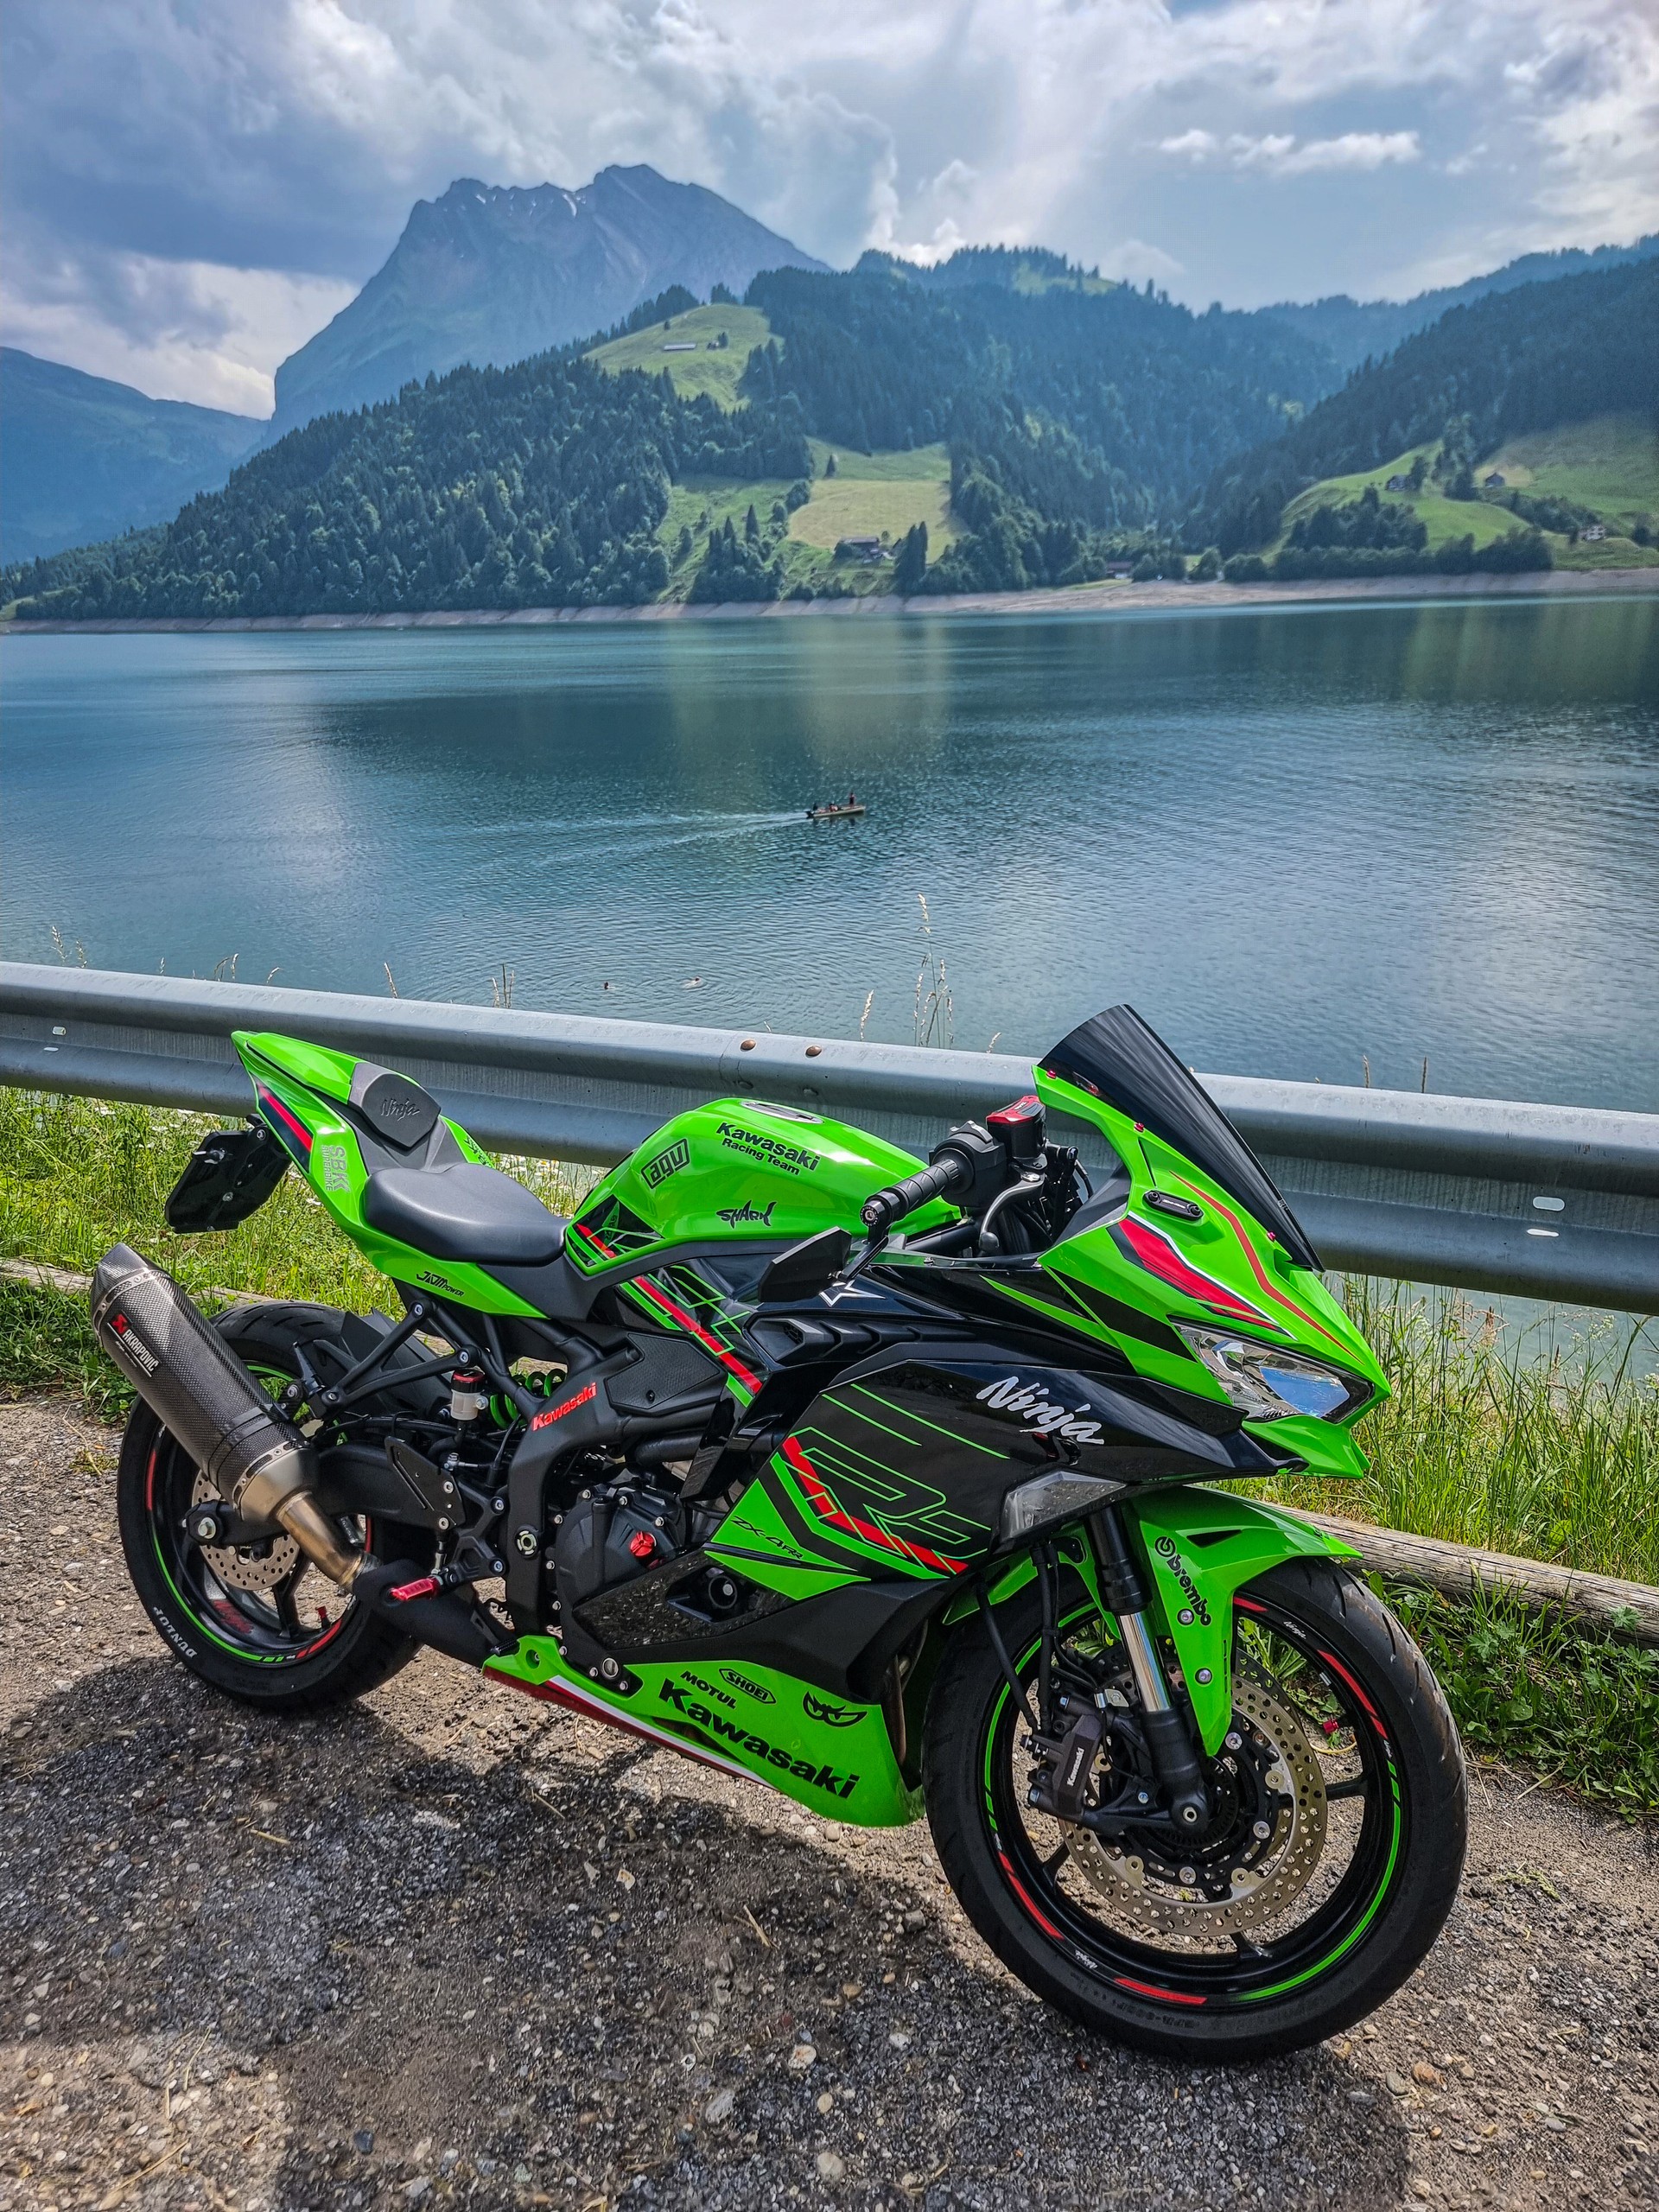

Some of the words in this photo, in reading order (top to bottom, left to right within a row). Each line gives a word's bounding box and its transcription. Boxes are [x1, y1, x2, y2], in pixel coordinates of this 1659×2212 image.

[380, 1097, 420, 1122] Ninja
[715, 1122, 820, 1171] Kawasaki
[721, 1137, 766, 1160] Racing
[766, 1154, 800, 1175] Team
[715, 1199, 778, 1229] SHARK
[442, 1284, 465, 1297] POWER
[532, 1382, 597, 1431] Kawasaki
[976, 1376, 1105, 1445] Ninja
[1166, 1554, 1212, 1626] brembo
[680, 1669, 736, 1710] MOTUL
[726, 1670, 769, 1701] SHOEI
[658, 1677, 861, 1799] Kawasaki
[1066, 1746, 1085, 1787] Kawasaki
